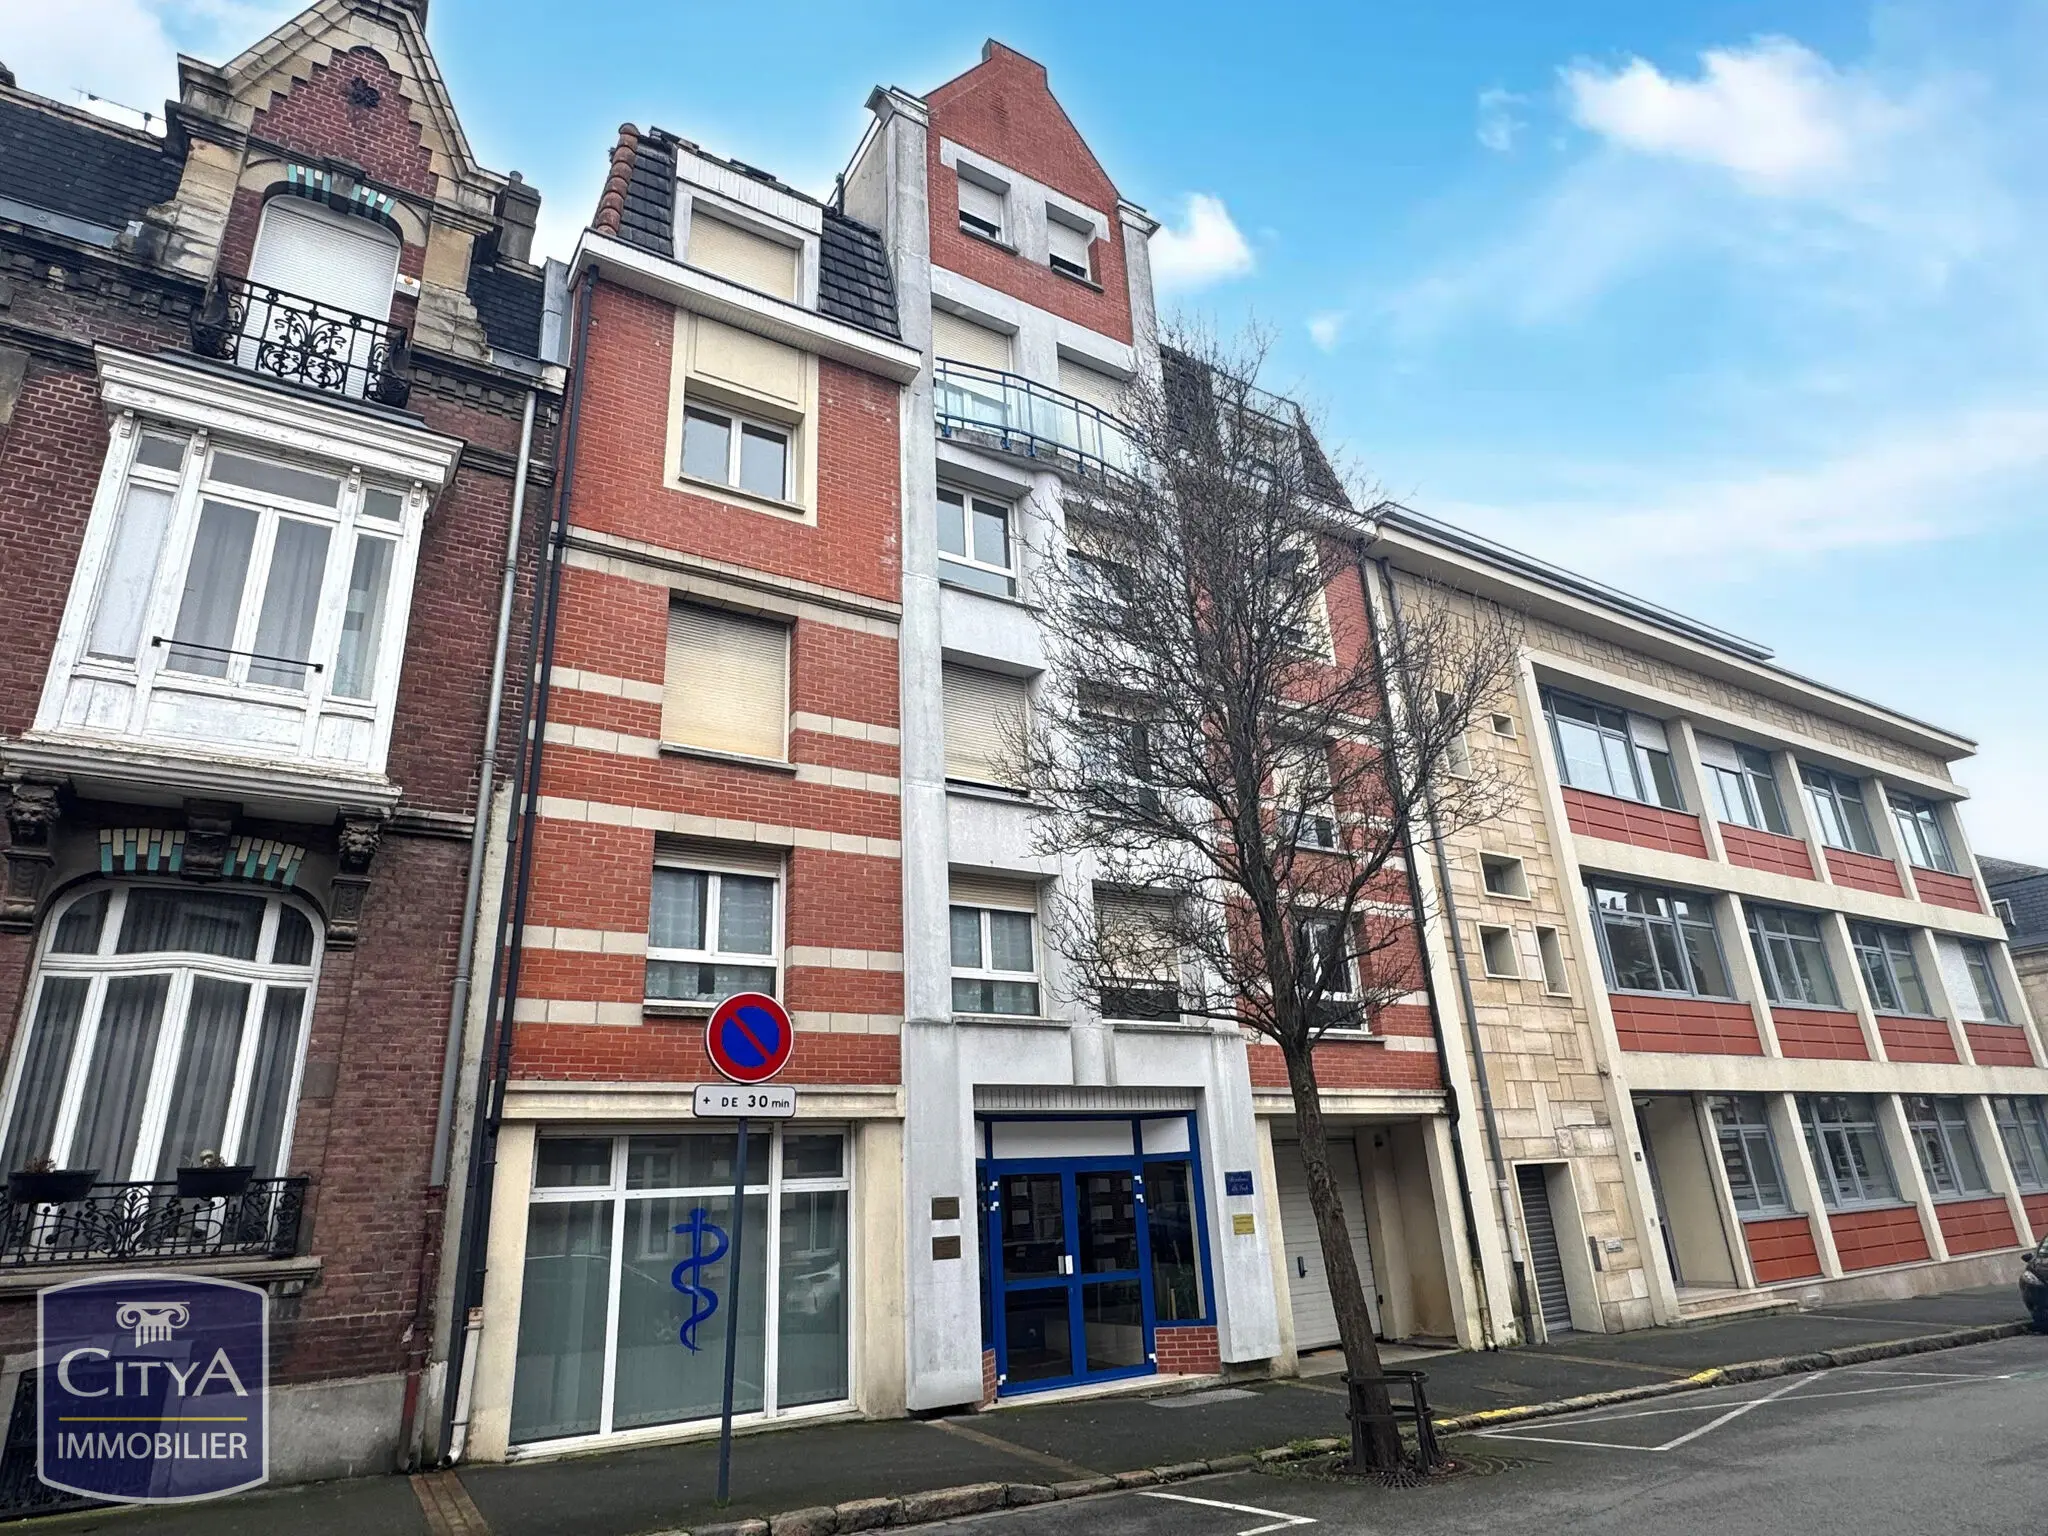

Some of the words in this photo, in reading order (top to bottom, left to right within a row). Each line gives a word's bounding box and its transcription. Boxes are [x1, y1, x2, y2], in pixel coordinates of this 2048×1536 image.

[703, 1096, 710, 1104] +
[721, 1097, 738, 1107] DE
[748, 1095, 768, 1108] 30
[771, 1099, 790, 1108] min
